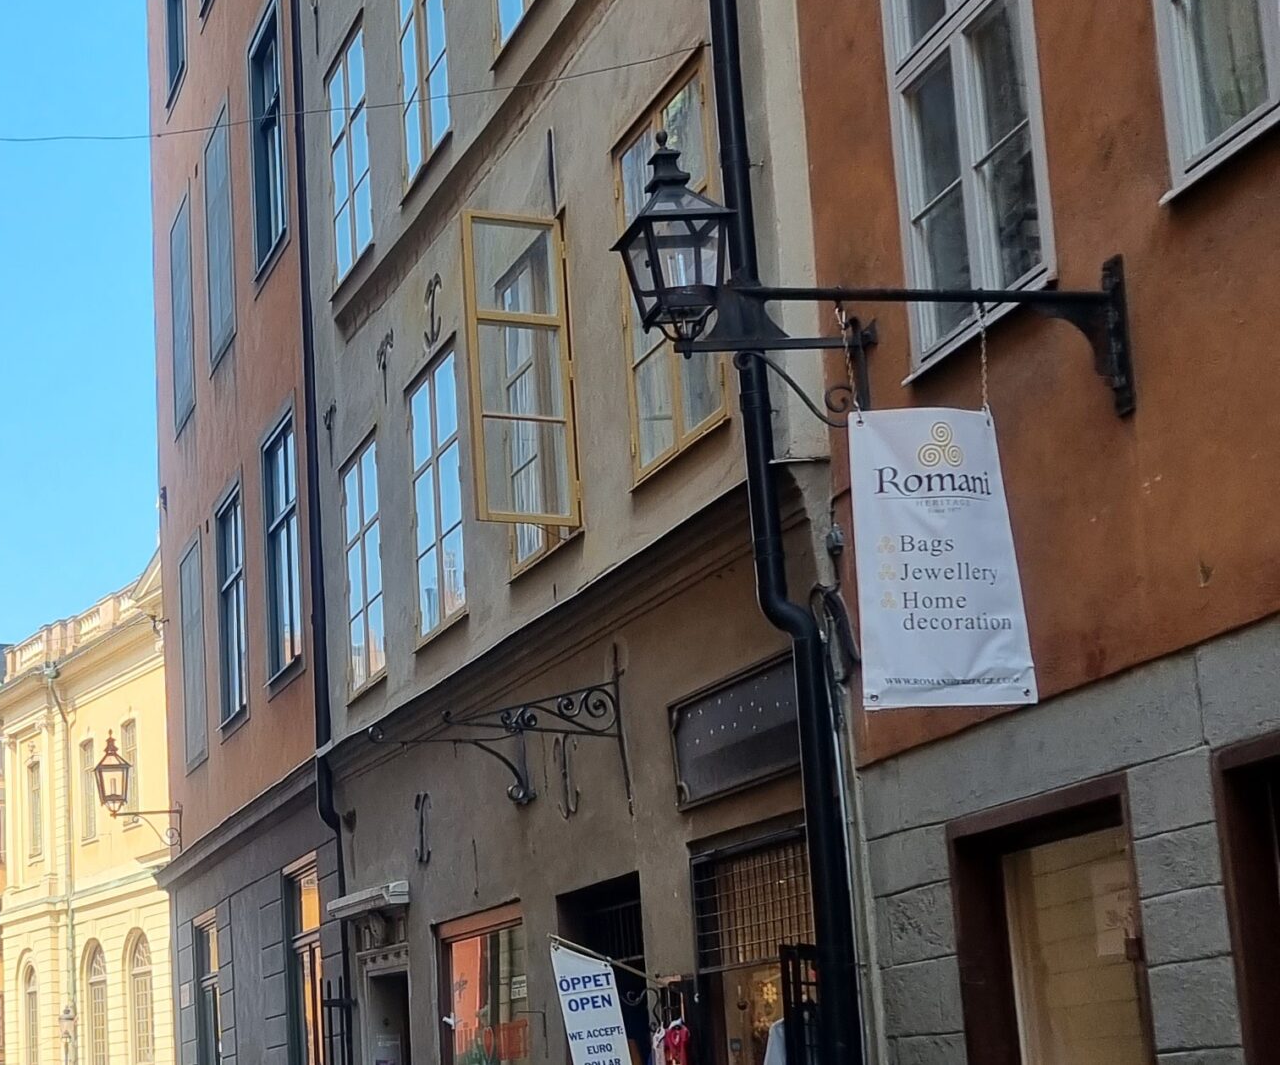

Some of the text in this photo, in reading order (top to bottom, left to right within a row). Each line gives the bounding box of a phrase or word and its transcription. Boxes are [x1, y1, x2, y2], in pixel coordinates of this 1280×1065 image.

[873, 466, 992, 496] Romani
[900, 535, 954, 557] Bags
[900, 562, 998, 585] Jewellery
[903, 592, 967, 609] Home
[903, 613, 1012, 631] decoration
[559, 973, 612, 992] ÖPPET
[568, 994, 612, 1012] OPEN
[569, 1026, 624, 1041] WE ACCEPT:
[586, 1043, 613, 1054] EURO
